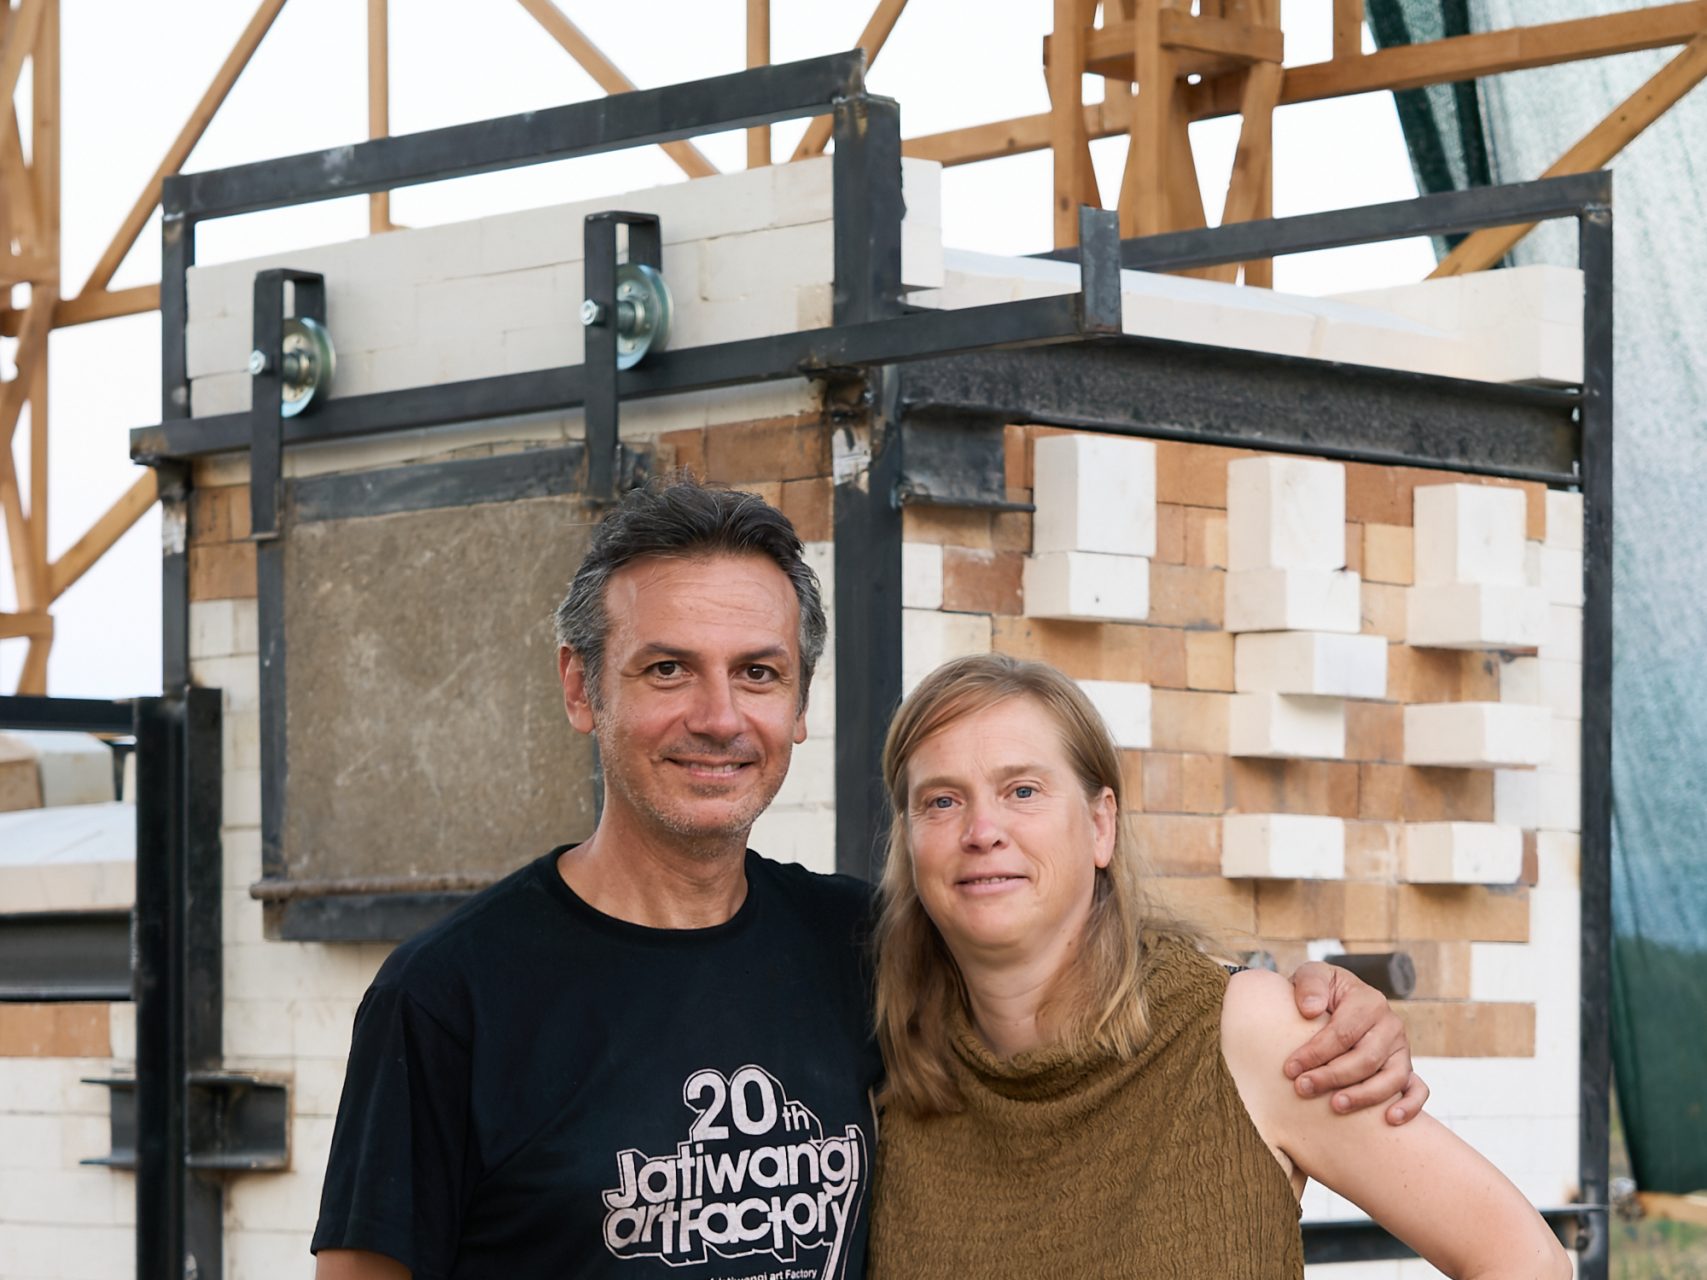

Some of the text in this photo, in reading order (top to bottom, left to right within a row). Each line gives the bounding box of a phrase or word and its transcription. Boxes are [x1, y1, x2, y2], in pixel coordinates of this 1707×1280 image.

[686, 1068, 811, 1142] 20th
[604, 1128, 859, 1208] Jatiwangi
[769, 1270, 785, 1280] art
[785, 1268, 818, 1280] Factory
